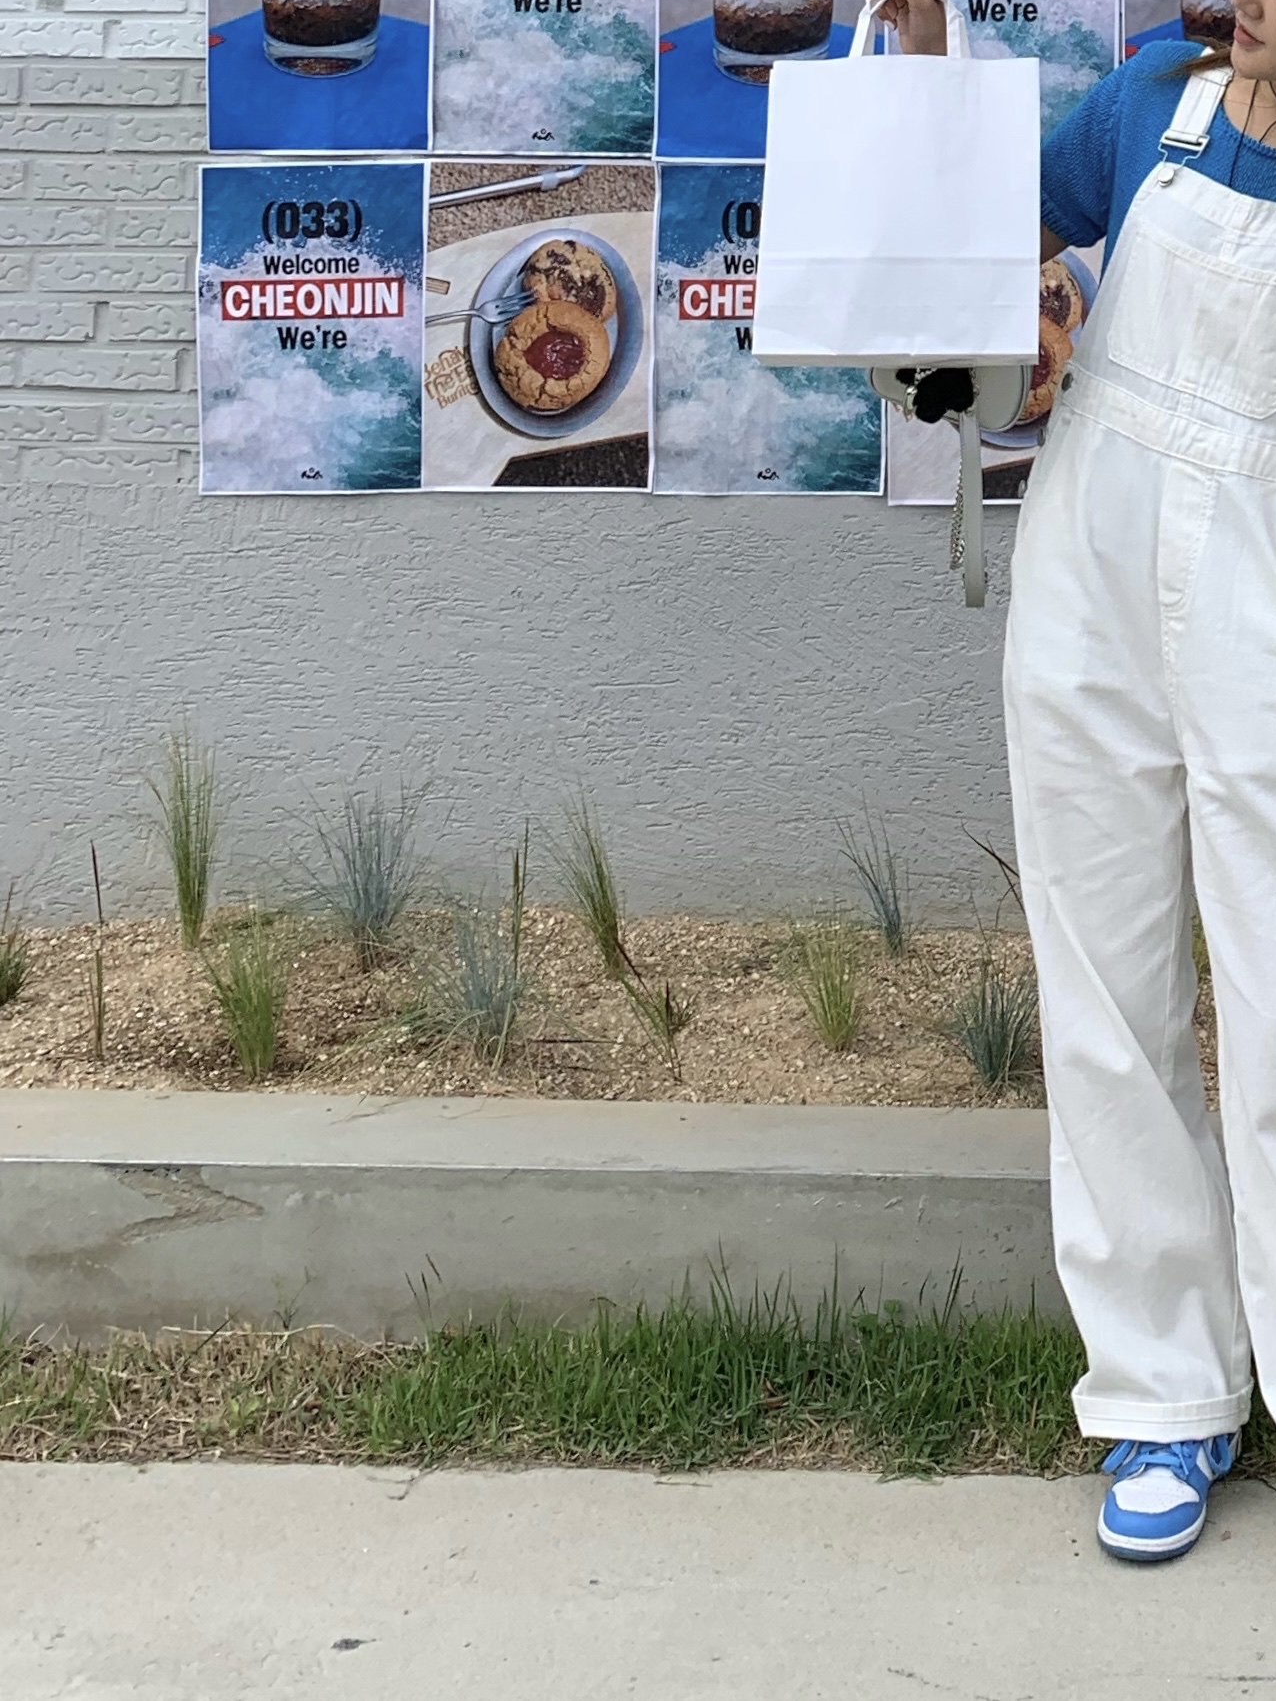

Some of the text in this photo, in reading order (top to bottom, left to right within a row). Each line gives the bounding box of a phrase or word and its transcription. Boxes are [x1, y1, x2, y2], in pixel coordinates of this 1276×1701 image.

[262, 200, 363, 244] (033)
[263, 254, 360, 275] Welcome
[224, 283, 400, 318] CHEONJIN
[277, 325, 348, 351] We're
